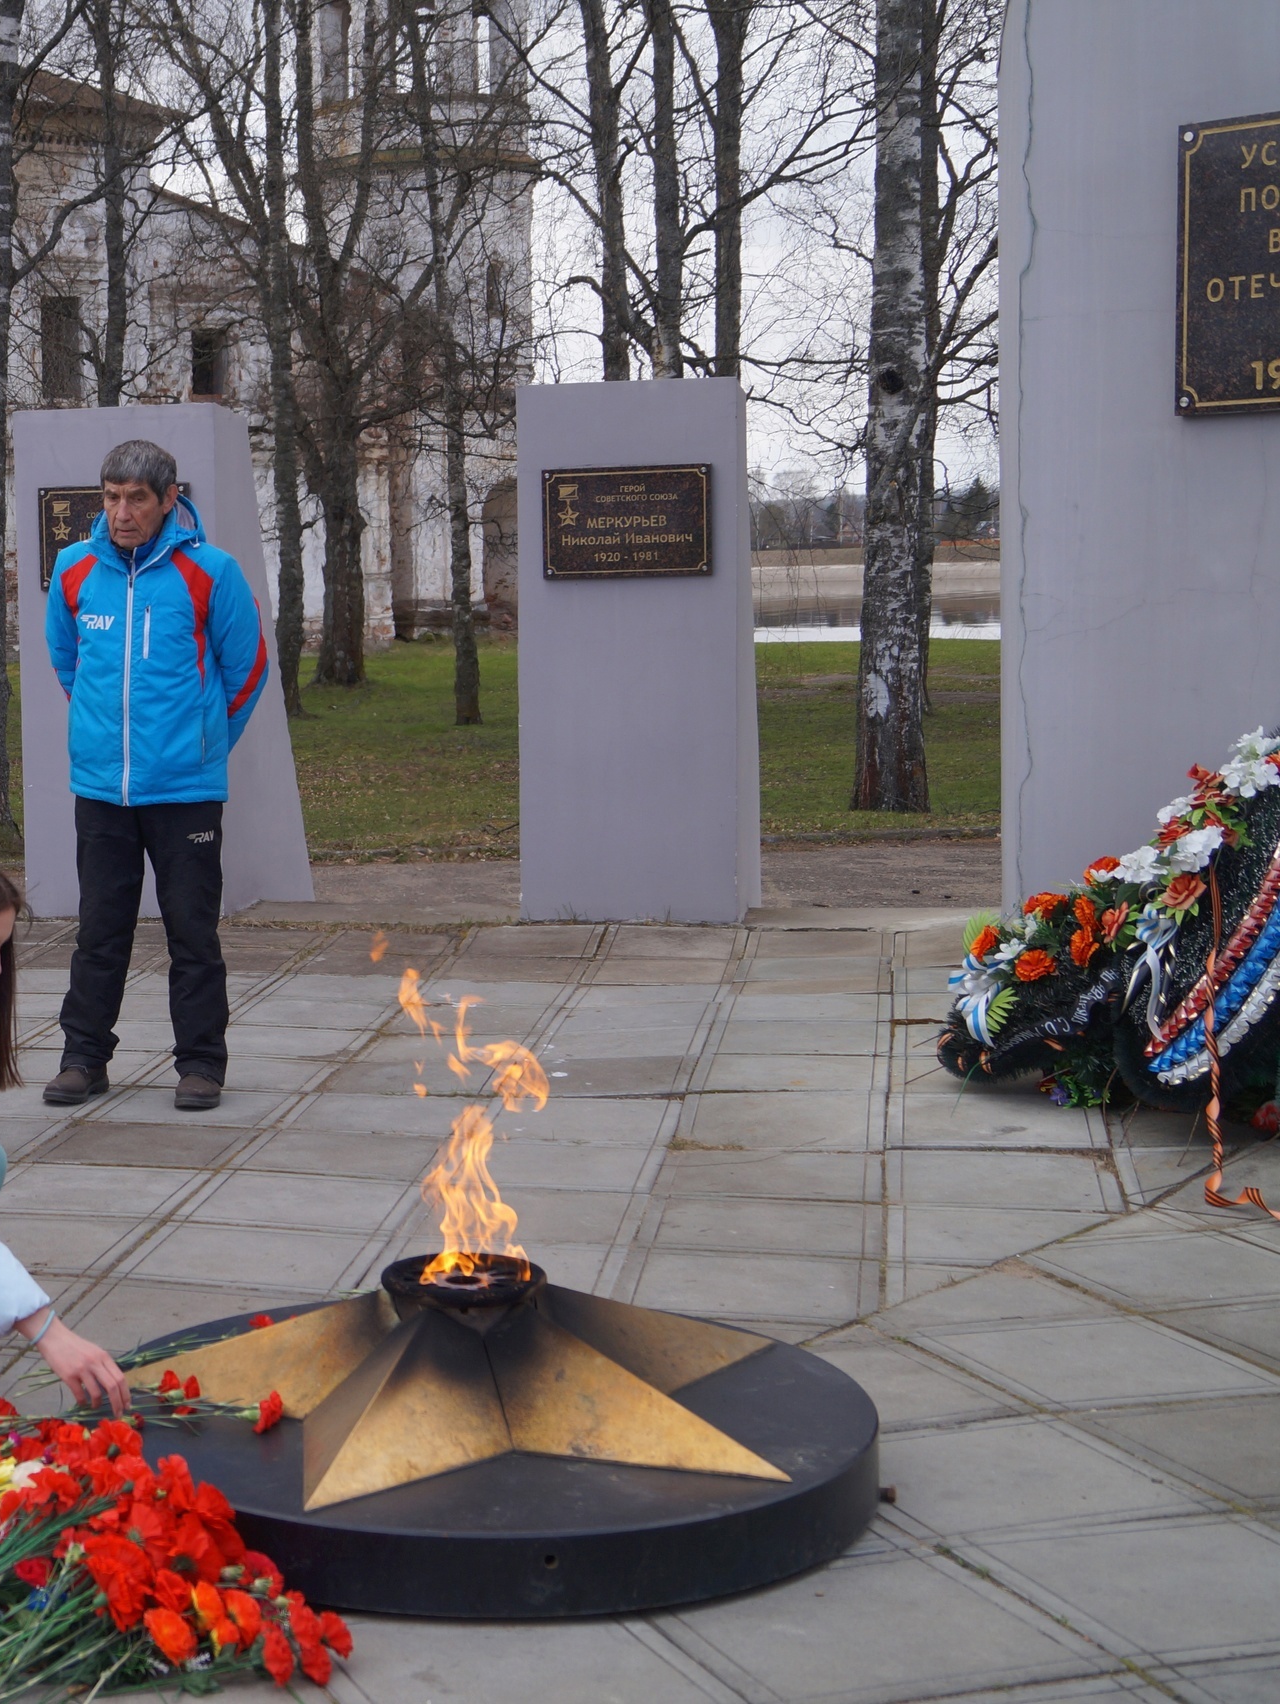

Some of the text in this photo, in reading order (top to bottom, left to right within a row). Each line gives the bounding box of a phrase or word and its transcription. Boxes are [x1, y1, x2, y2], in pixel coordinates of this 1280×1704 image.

[619, 483, 646, 493] ГЕРОЙ
[595, 493, 678, 503] СОВЕТСКОГО СОЮЗА
[586, 515, 667, 529] МЕРКУРЬЕВ
[561, 532, 693, 546] Николай Иванович
[593, 552, 620, 562] 1920
[632, 551, 659, 561] 1981
[80, 614, 115, 630] RAY
[186, 830, 214, 844] RAY
